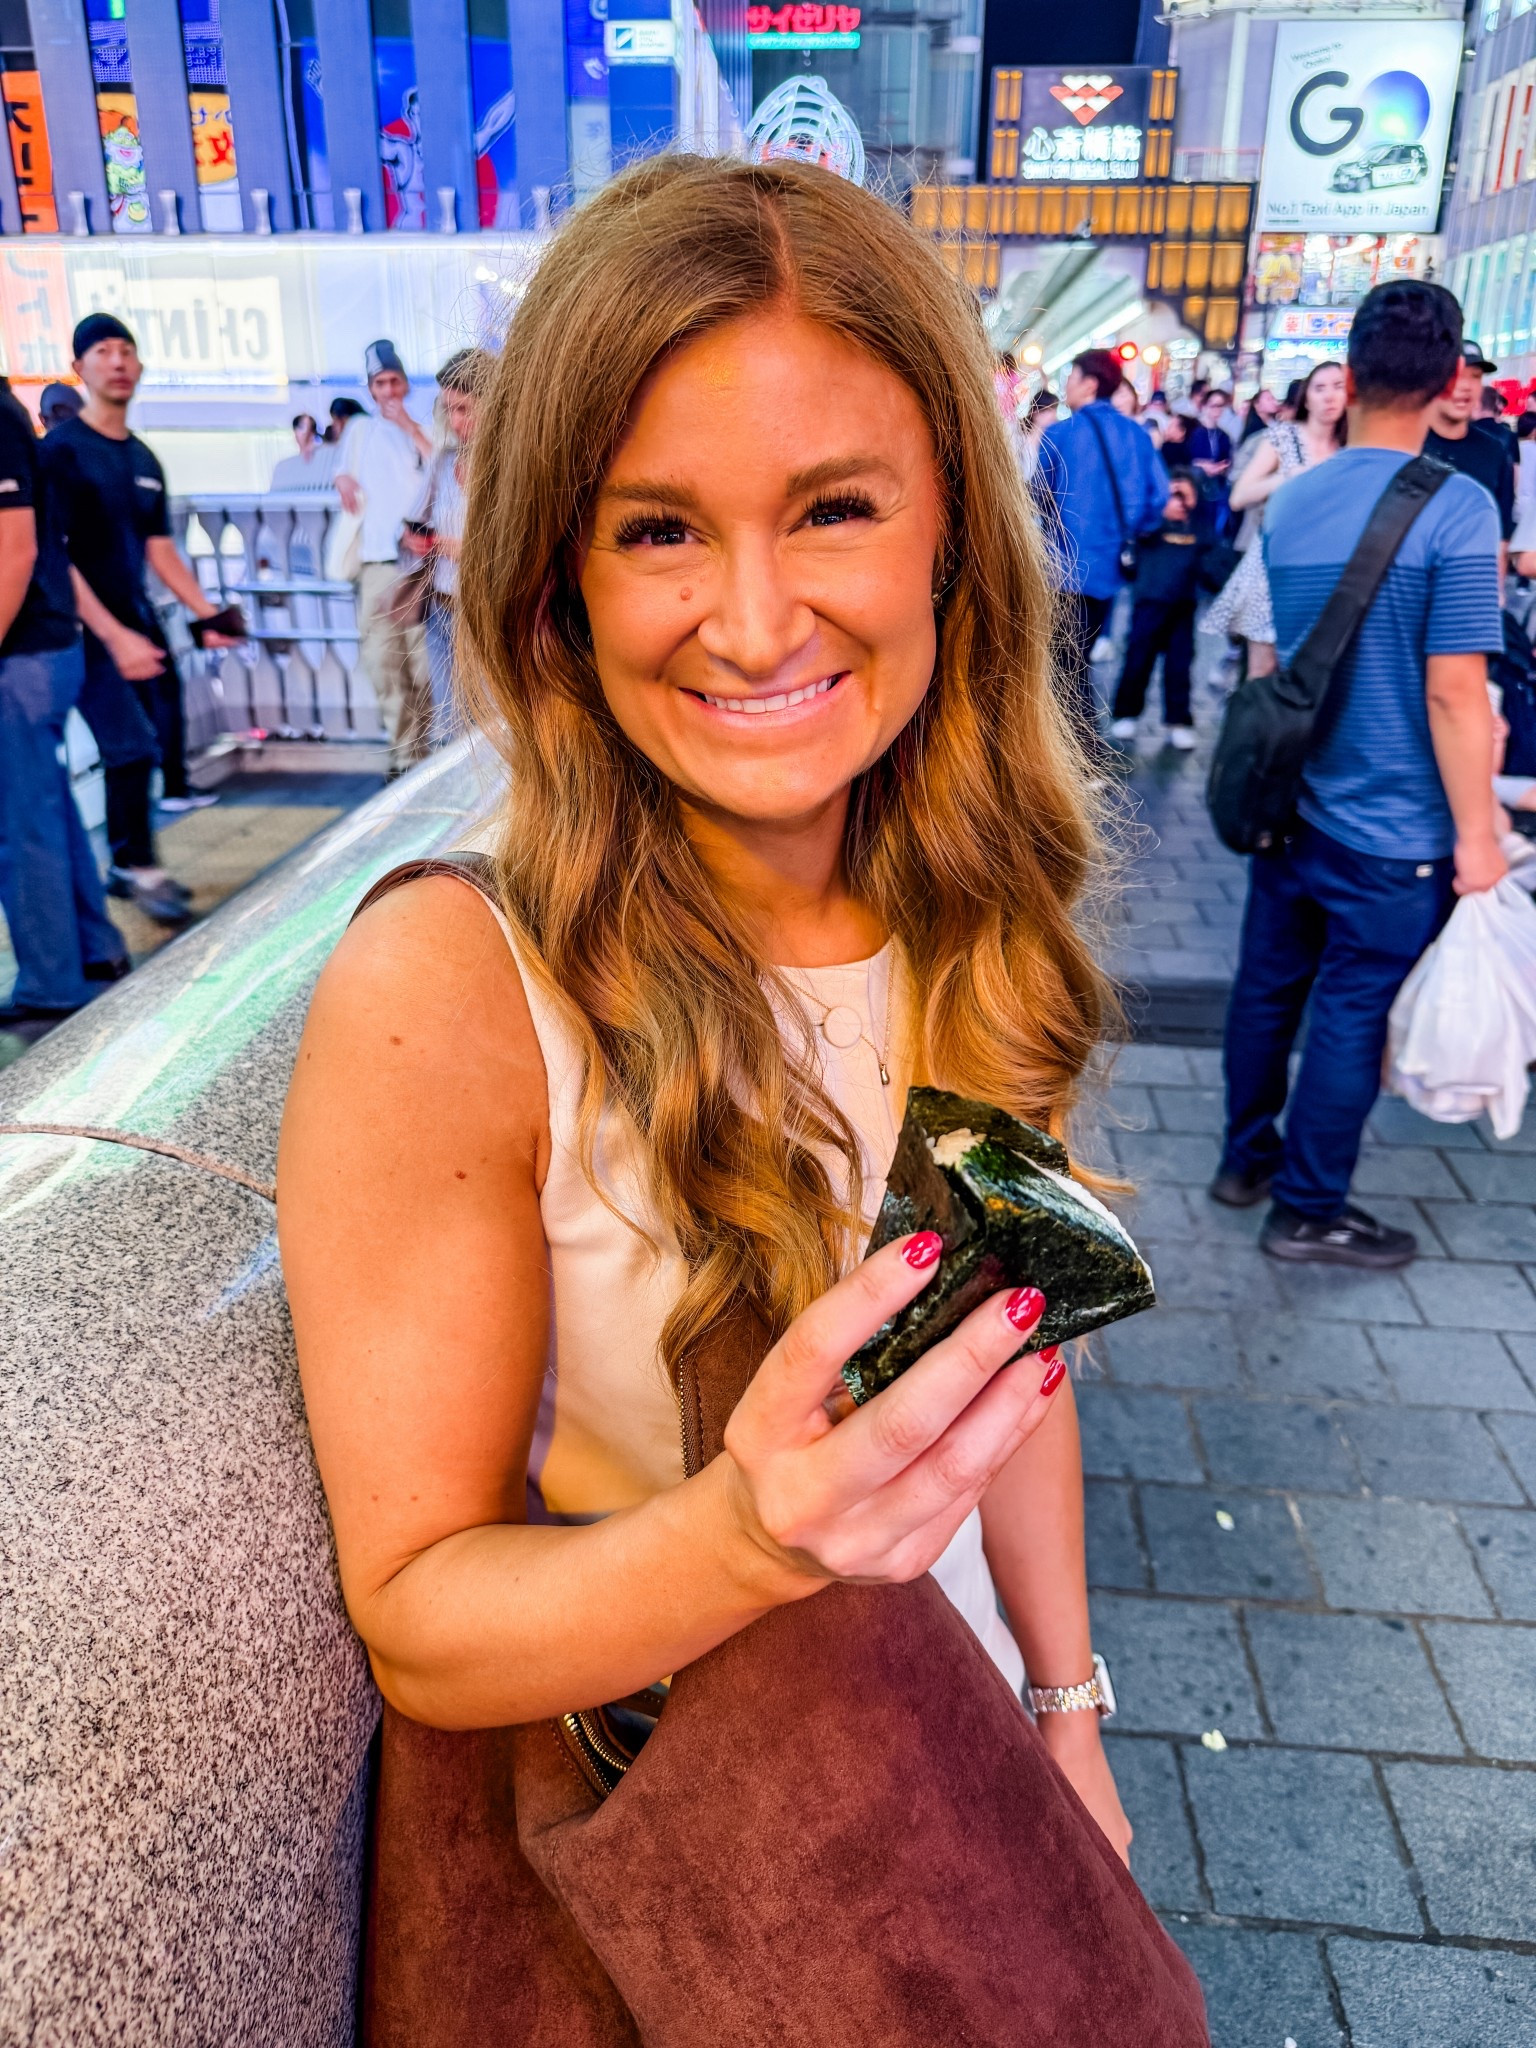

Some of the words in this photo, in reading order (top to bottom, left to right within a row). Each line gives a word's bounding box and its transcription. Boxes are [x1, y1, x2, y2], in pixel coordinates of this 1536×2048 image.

[745, 3, 861, 33] サイゼリヤ
[1302, 201, 1330, 215] Taxi
[1333, 201, 1363, 218] App
[1368, 201, 1380, 215] in
[1384, 202, 1428, 218] Japan
